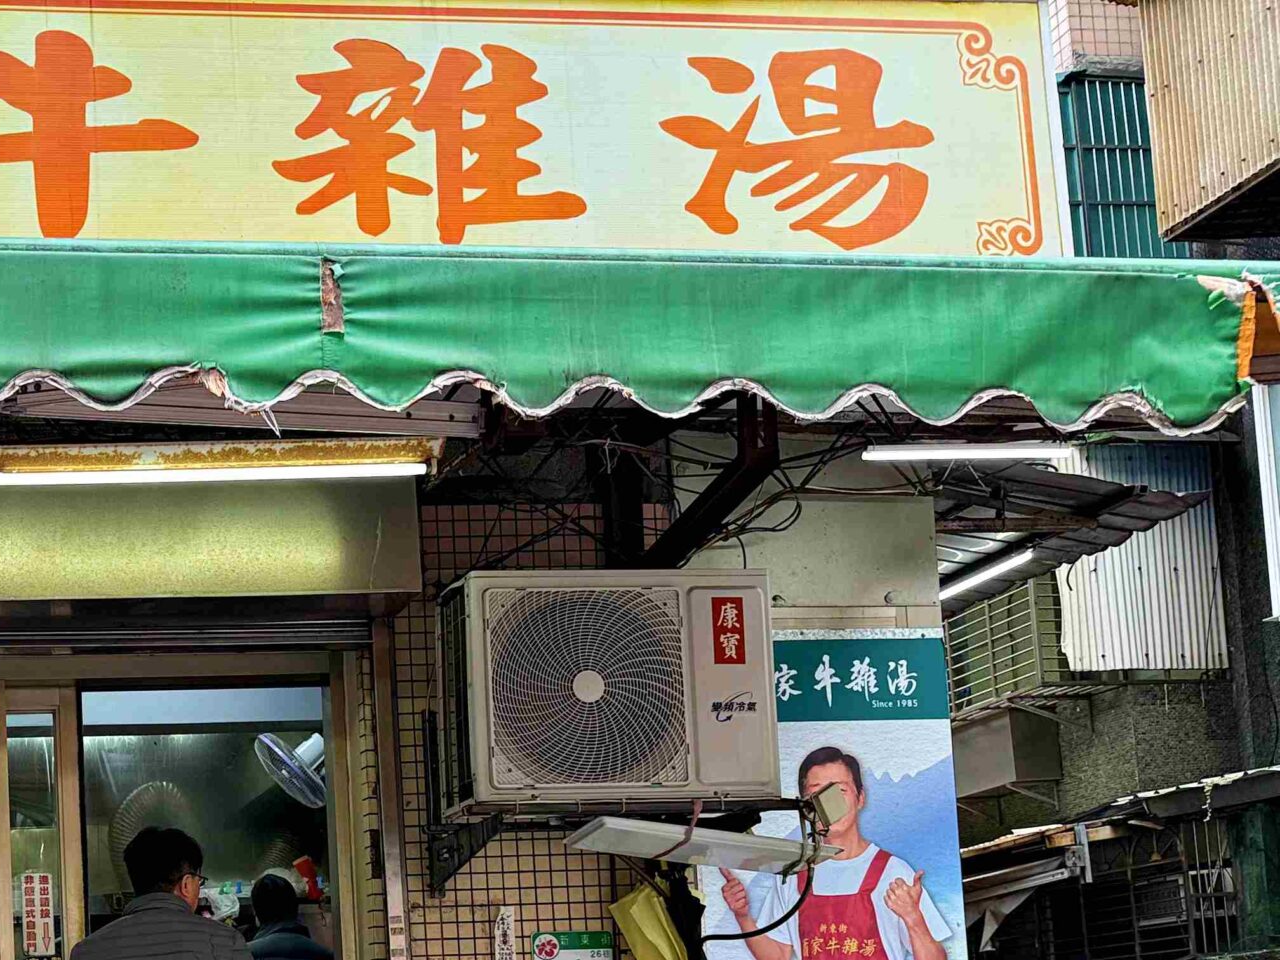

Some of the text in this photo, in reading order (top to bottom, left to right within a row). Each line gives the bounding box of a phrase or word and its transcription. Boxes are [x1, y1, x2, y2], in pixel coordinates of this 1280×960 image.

[717, 602, 740, 659] 康寶
[711, 702, 757, 712] 變頻冷氣
[872, 699, 918, 708] Since 1985
[560, 934, 612, 946] 新東街
[590, 950, 610, 958] 26巷
